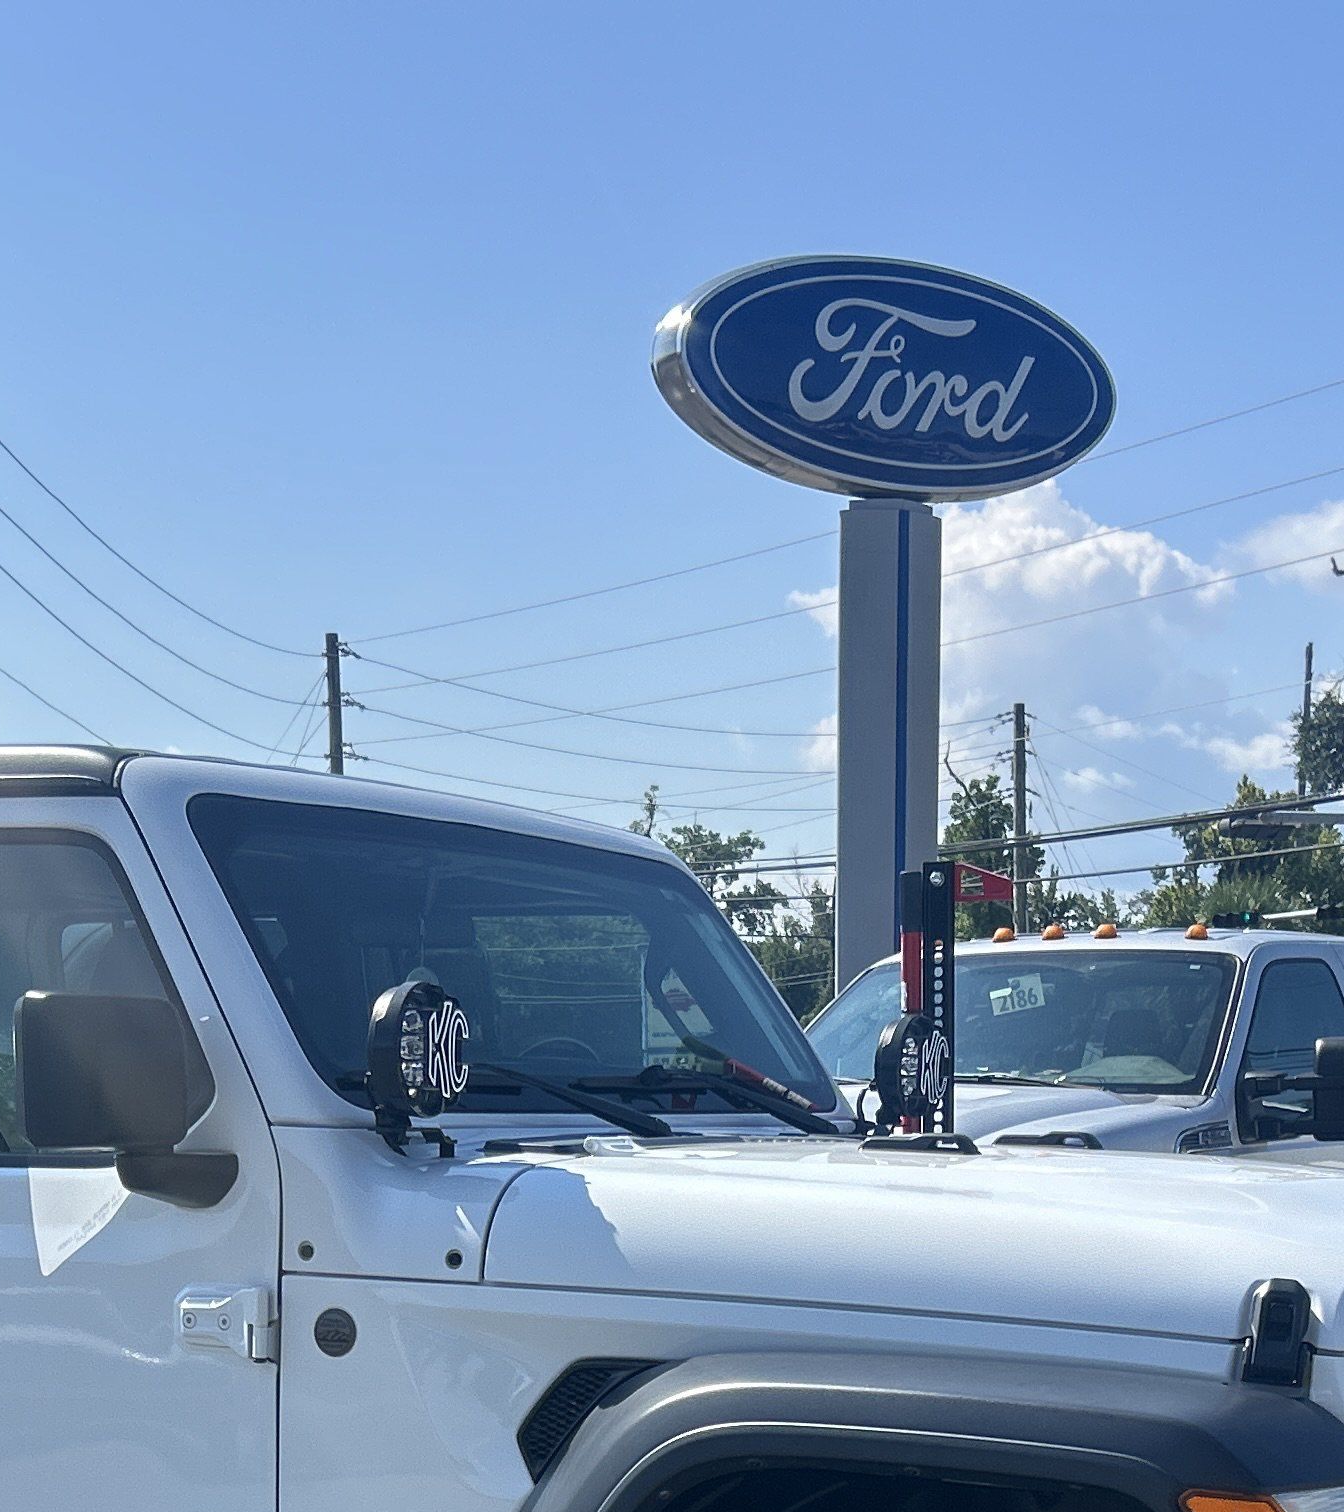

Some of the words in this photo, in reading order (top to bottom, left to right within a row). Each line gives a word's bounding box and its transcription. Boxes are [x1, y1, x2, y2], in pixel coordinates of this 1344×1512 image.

[788, 298, 1036, 442] Ford
[429, 1001, 470, 1098] KC
[920, 1030, 950, 1104] KC
